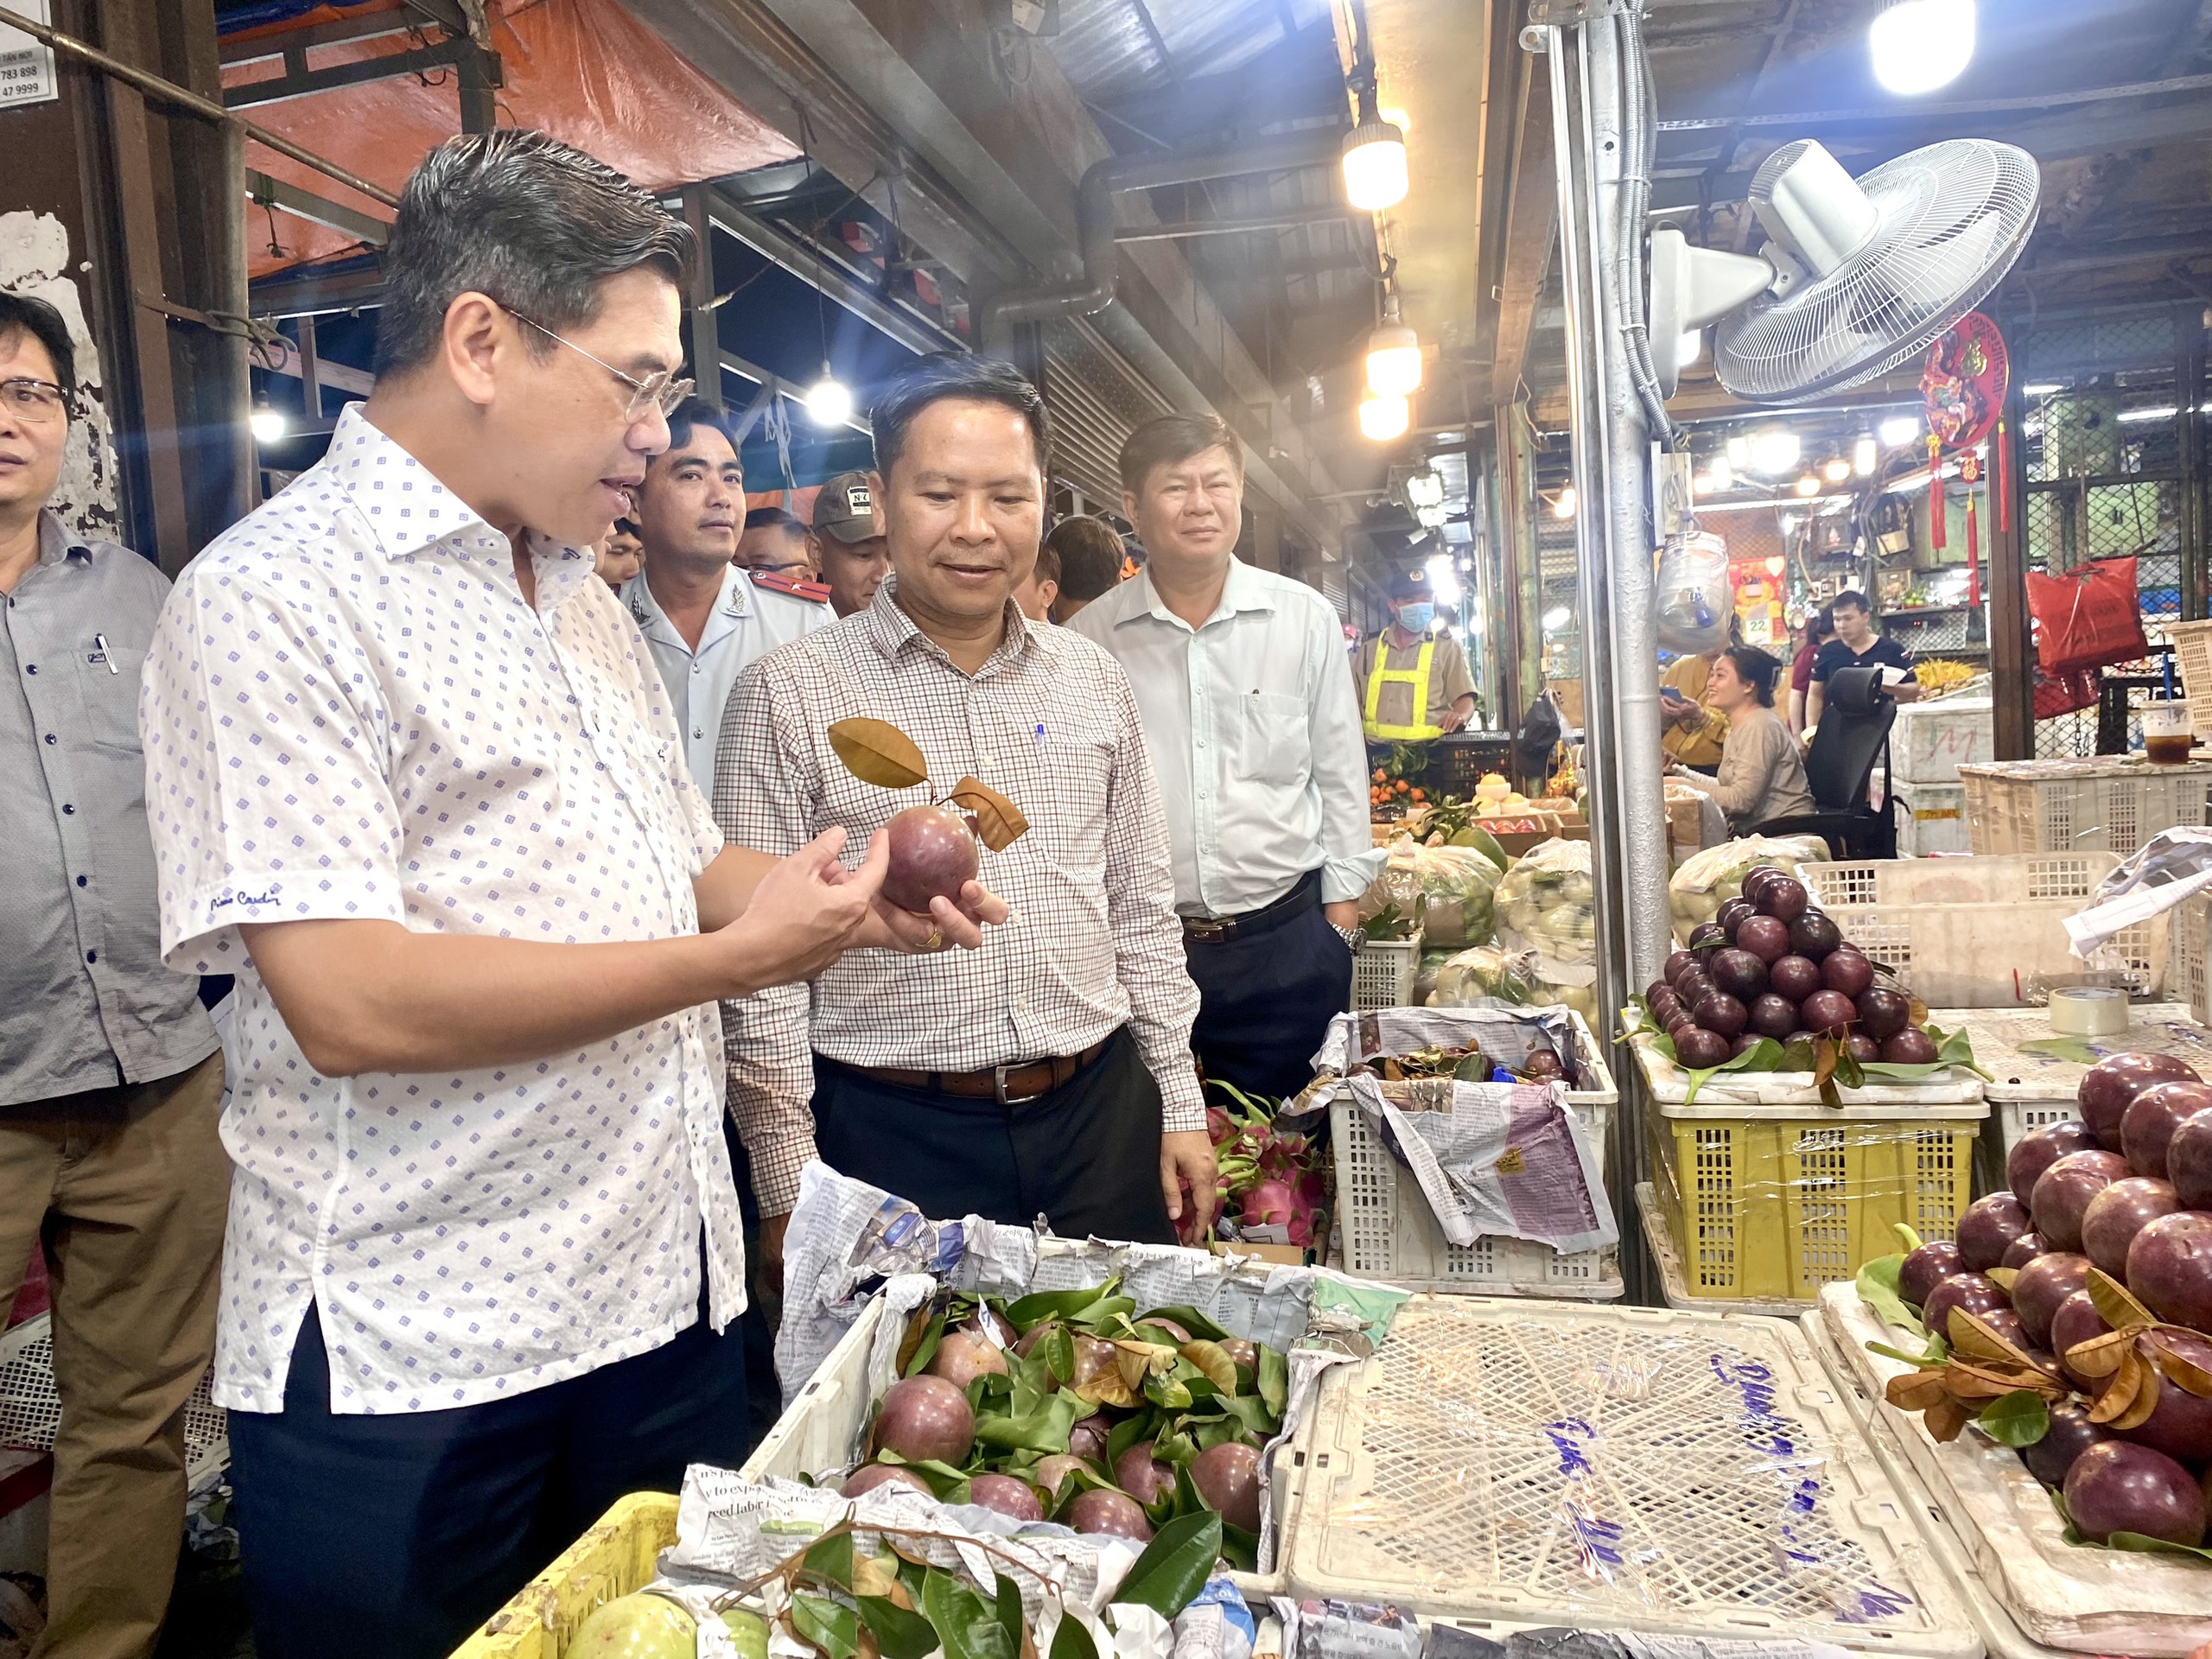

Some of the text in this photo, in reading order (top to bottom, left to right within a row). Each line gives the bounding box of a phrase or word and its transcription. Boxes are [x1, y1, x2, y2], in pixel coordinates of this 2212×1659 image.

[1, 65, 37, 80] 783 898
[3, 82, 39, 97] 47 9999
[1751, 620, 1766, 632] 22
[715, 1484, 728, 1497] to
